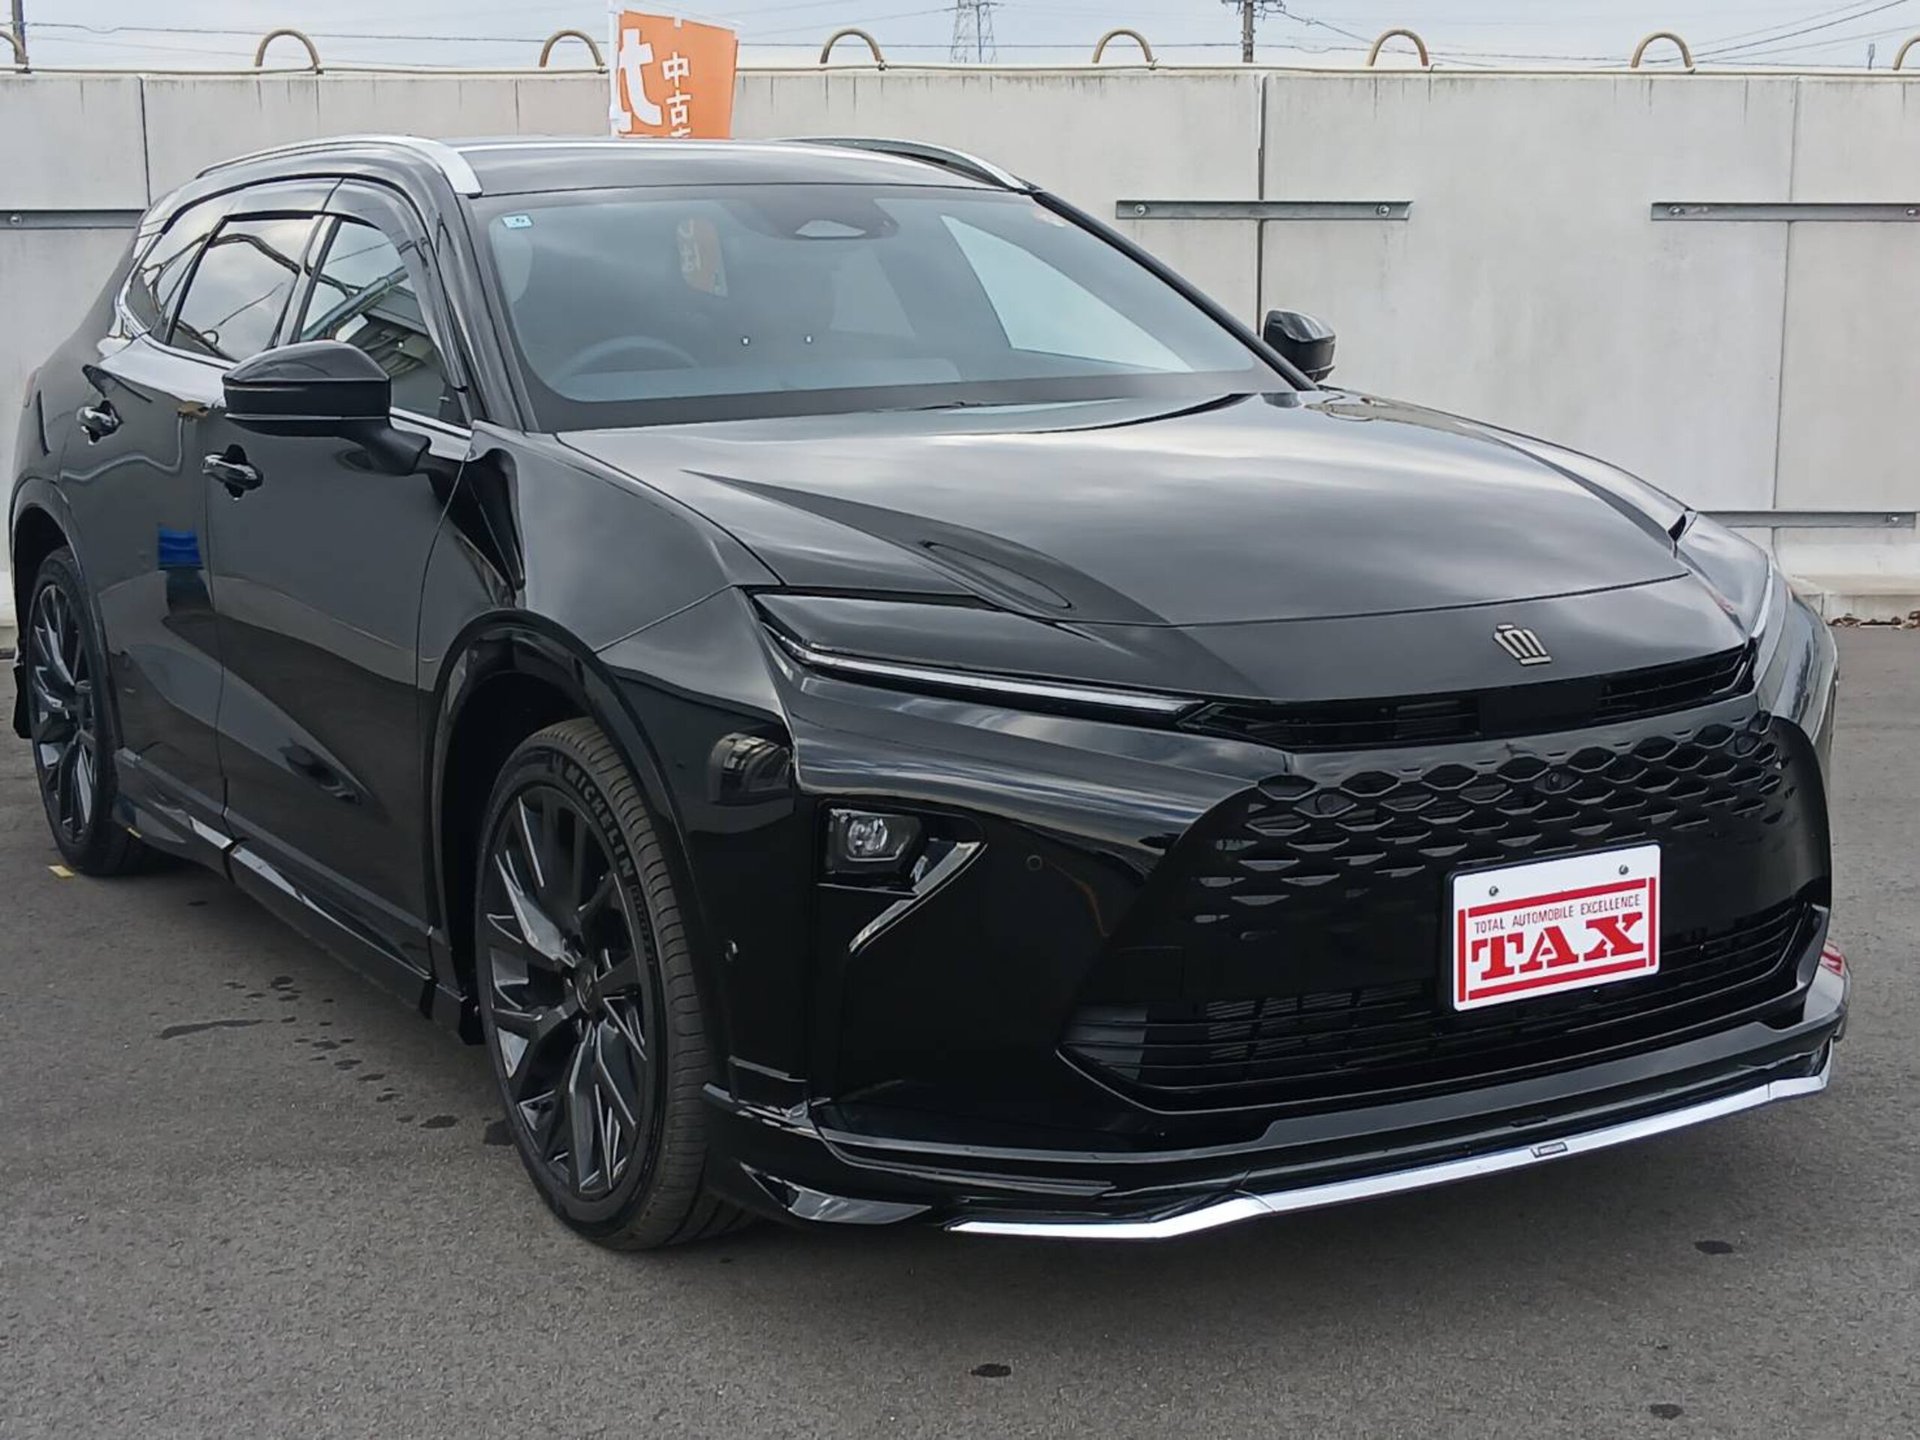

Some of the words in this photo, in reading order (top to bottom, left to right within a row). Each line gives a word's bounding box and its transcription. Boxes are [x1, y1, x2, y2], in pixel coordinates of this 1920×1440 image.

[564, 763, 634, 877] MICHELIN
[1471, 911, 1644, 981] TAX
[1474, 919, 1506, 934] TOTAL
[1512, 905, 1574, 927] AUTOMOBILE
[1580, 894, 1641, 916] EXCELLENCE
